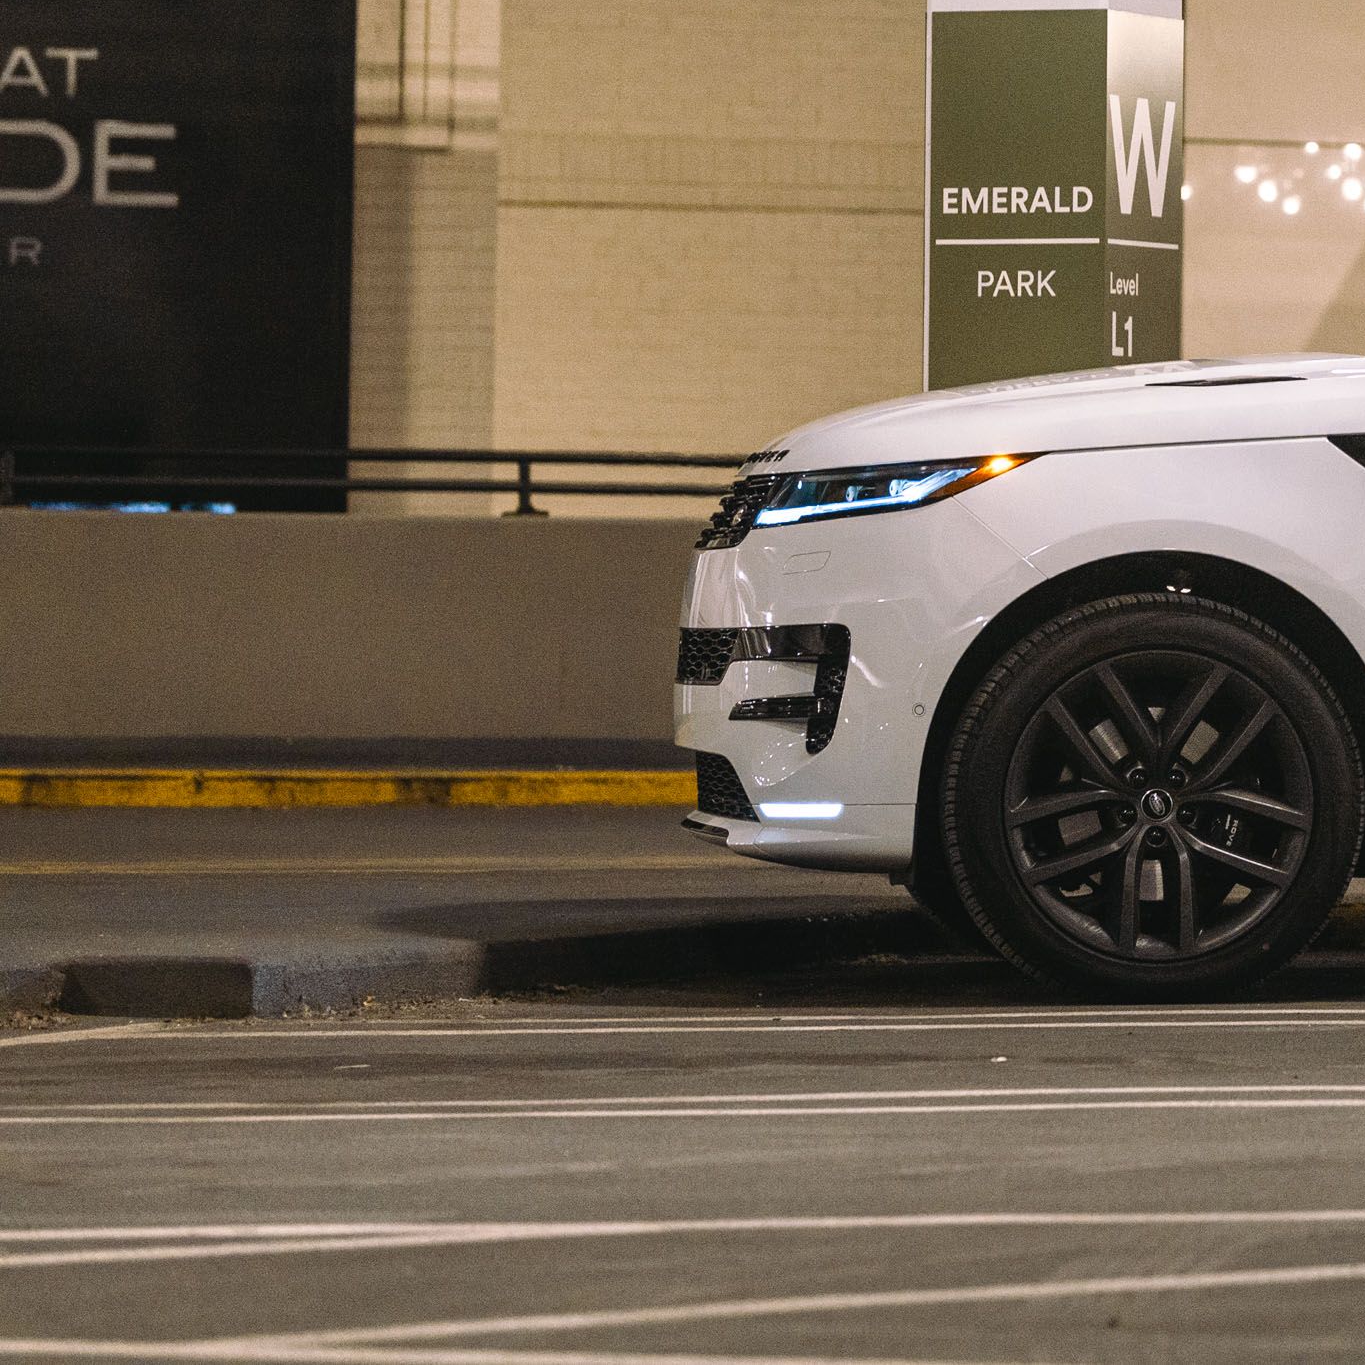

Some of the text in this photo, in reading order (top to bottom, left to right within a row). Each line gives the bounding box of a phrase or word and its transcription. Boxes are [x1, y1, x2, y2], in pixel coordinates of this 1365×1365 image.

[1109, 94, 1176, 218] W
[942, 186, 1094, 215] EMERALD
[977, 270, 1057, 298] PARK
[1109, 271, 1139, 297] Level
[1111, 311, 1133, 358] L1
